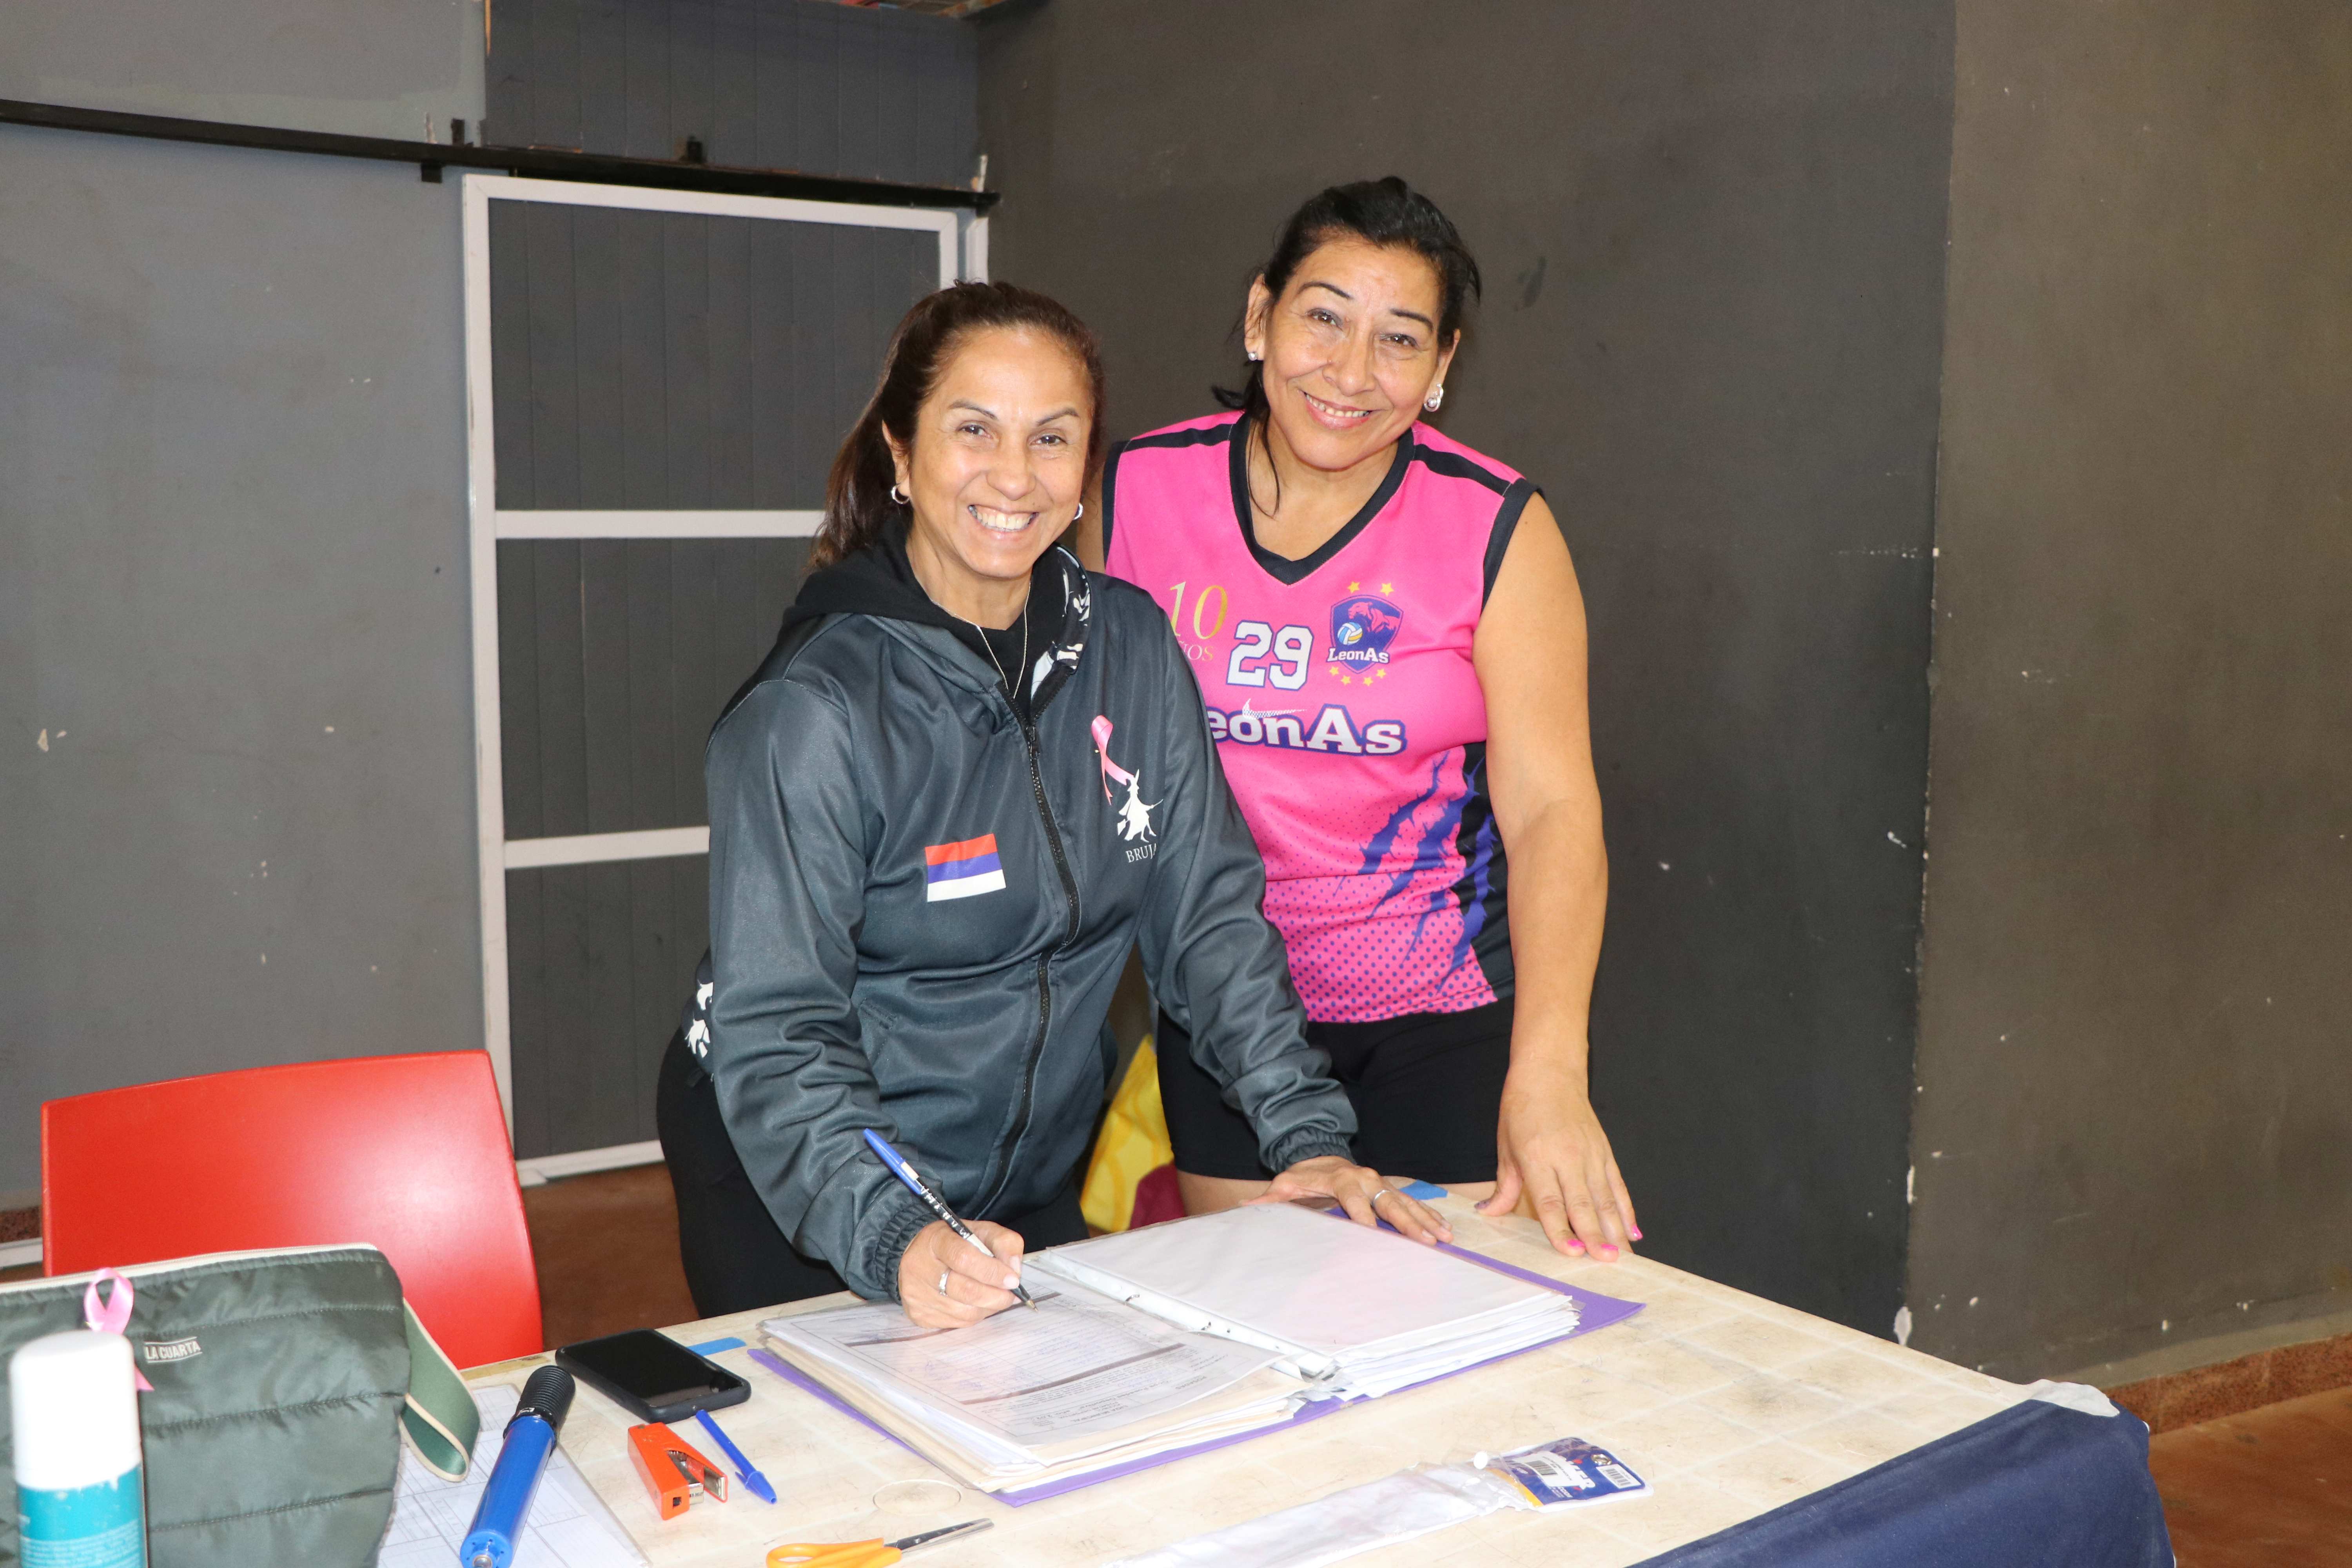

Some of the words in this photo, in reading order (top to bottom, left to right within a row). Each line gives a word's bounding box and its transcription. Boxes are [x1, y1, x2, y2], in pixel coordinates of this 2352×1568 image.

[1169, 581, 1228, 640] 10
[1226, 620, 1314, 691] 29
[1326, 647, 1390, 664] LeonAs
[1206, 704, 1408, 756] eonAs
[144, 1346, 159, 1359] LA
[158, 1341, 201, 1359] CUARTA
